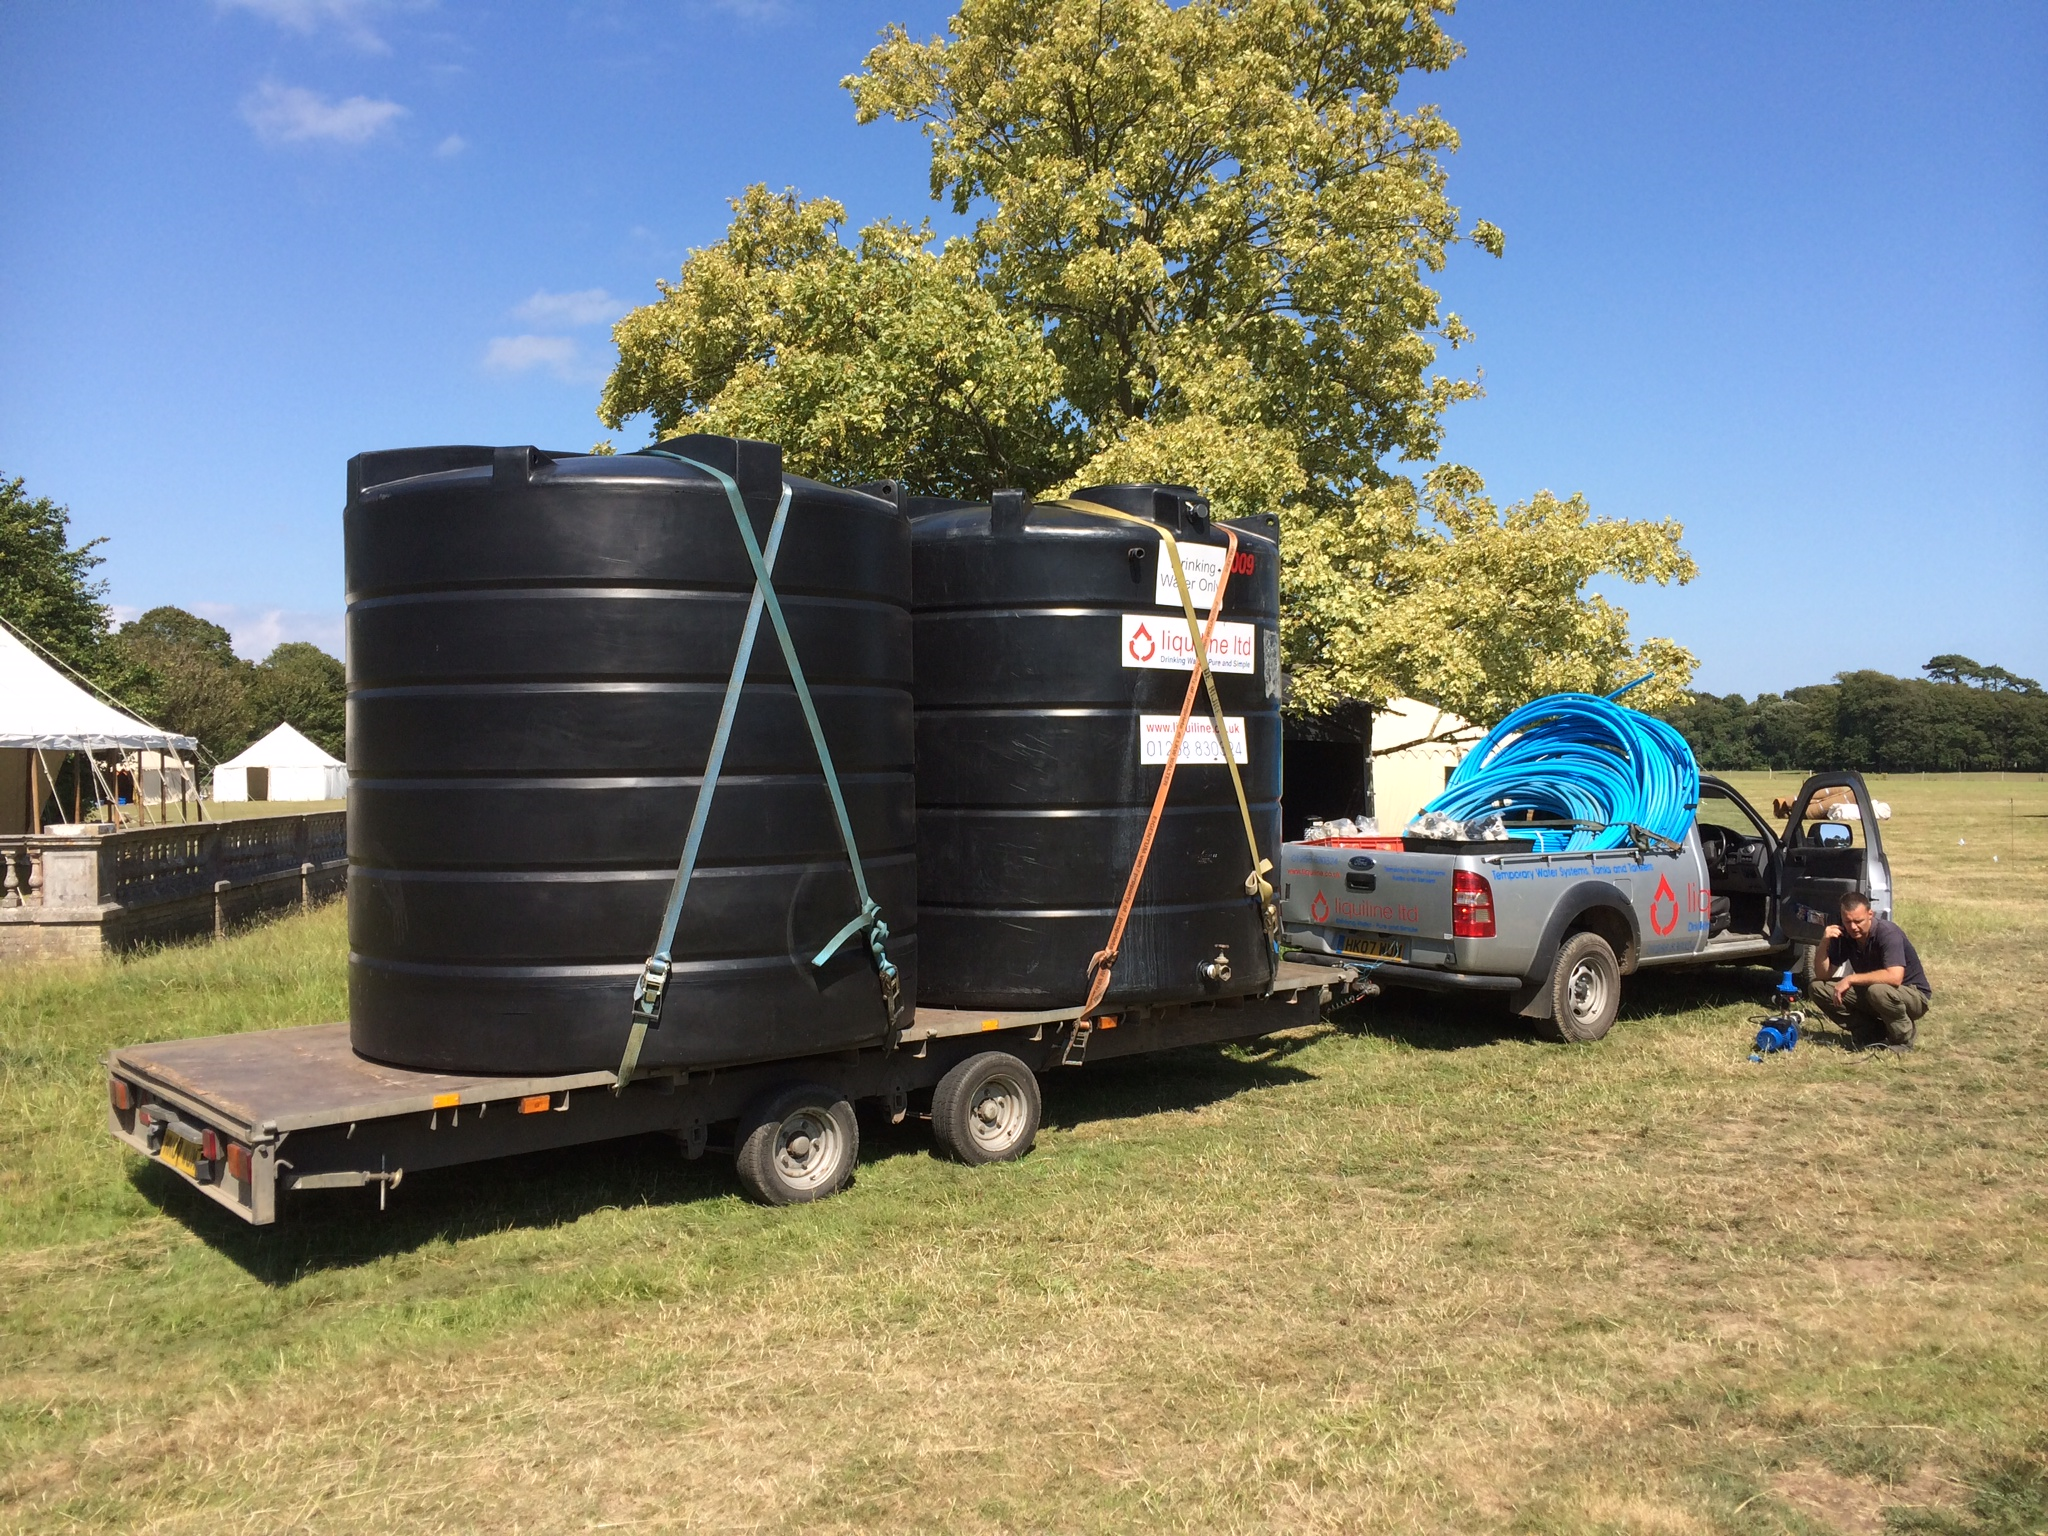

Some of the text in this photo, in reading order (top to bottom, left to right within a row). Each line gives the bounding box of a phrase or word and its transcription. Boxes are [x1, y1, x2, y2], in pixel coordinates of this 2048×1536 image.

[1172, 557, 1216, 577] rinking
[1160, 573, 1196, 590] Waer
[1162, 630, 1251, 657] liqune ltd
[1160, 656, 1186, 666] Drinking
[1208, 659, 1221, 667] Pure
[1233, 659, 1251, 669] Simple
[1146, 722, 1240, 734] www.liuiline.c.uk
[1162, 757, 1174, 786] WALTER
[1142, 816, 1157, 853] EIGENTUM
[1492, 870, 1534, 881] Temporary
[1535, 868, 1558, 878] Water
[1613, 864, 1627, 873] and
[1124, 873, 1138, 904] property
[1335, 897, 1418, 922] liquiline ltd
[1345, 938, 1376, 955] HK07
